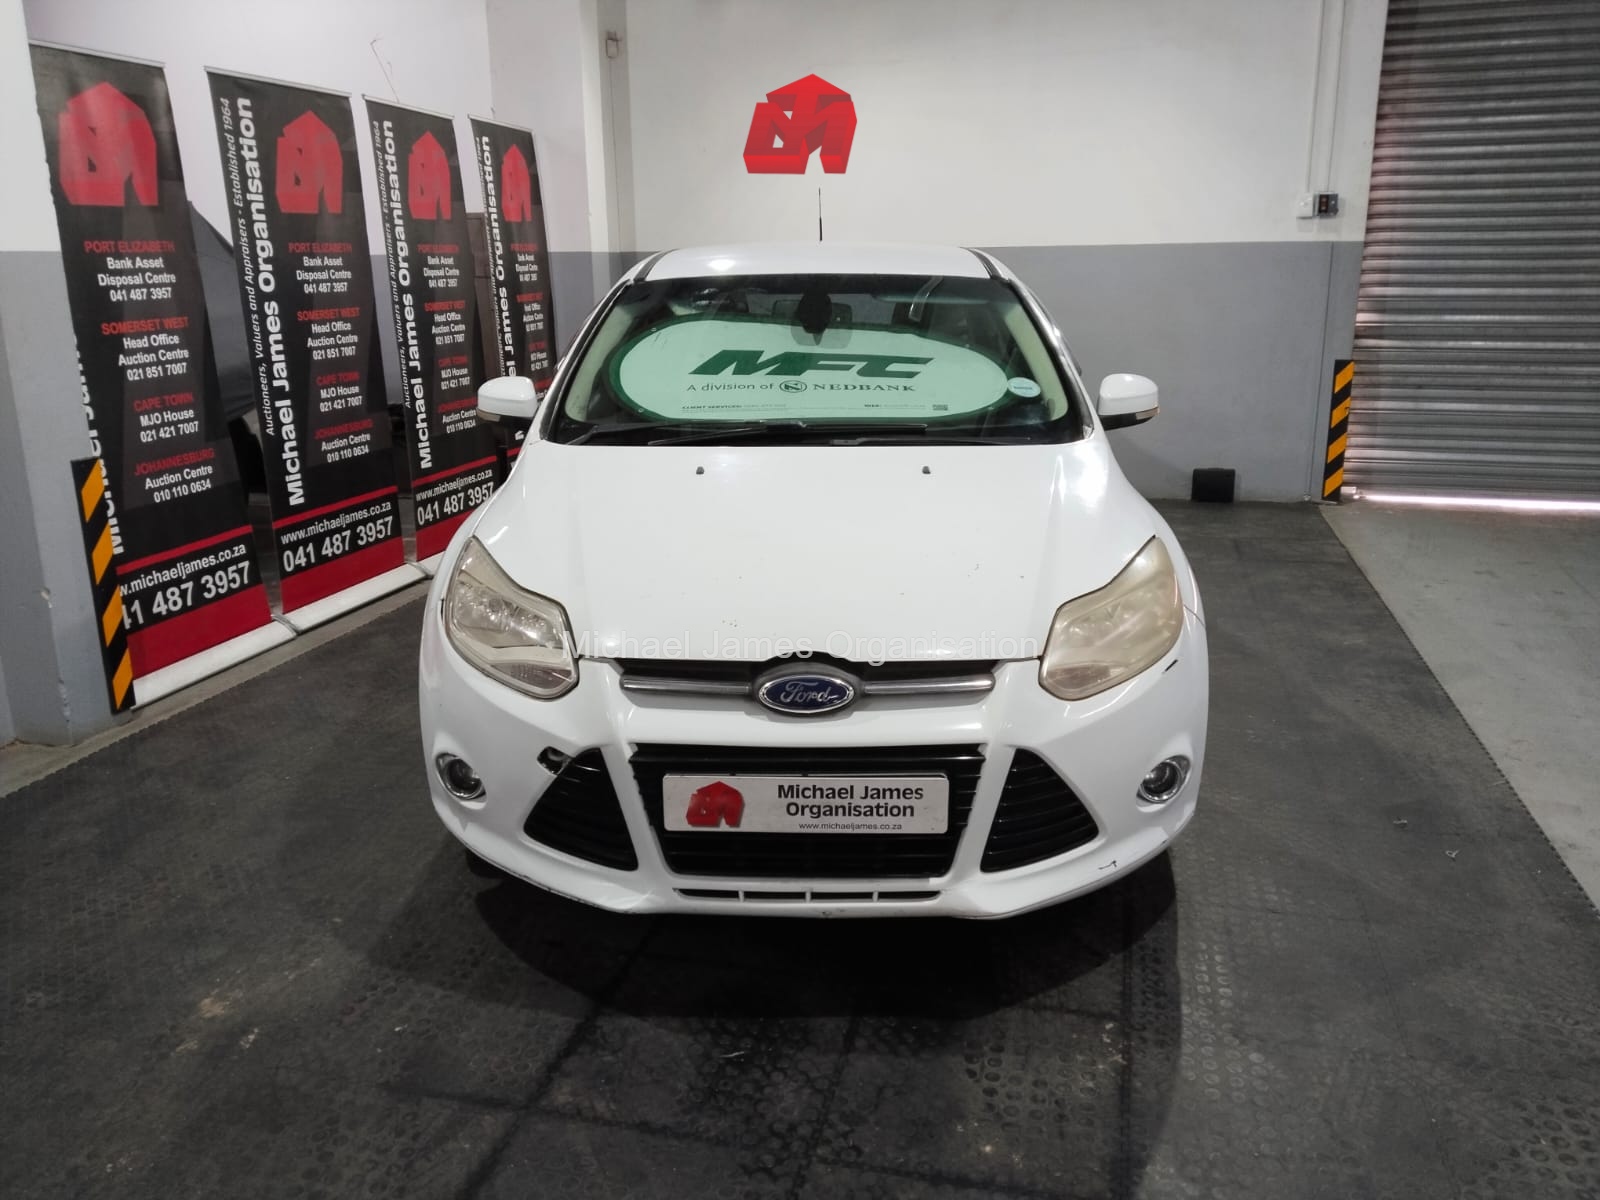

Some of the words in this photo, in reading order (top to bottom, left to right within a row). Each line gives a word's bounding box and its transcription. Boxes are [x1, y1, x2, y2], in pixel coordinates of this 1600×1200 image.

[220, 97, 233, 130] 1964
[226, 134, 244, 207] Established
[237, 97, 276, 293] Organisation
[383, 120, 411, 287] Organisation
[481, 135, 506, 282] Organisation
[84, 241, 114, 253] PORT
[237, 218, 255, 284] Appraisers
[106, 257, 133, 269] Bank
[135, 256, 164, 269] Asset
[303, 256, 322, 266] Bank
[324, 256, 343, 266] Asset
[97, 273, 143, 287] Disposal
[145, 272, 176, 284] Centre
[296, 270, 329, 282] Disposal
[330, 269, 352, 279] Centre
[110, 289, 127, 302] 041
[130, 288, 147, 301] 487
[151, 287, 172, 300] 3957
[246, 286, 258, 310] and
[304, 283, 317, 294] 041
[391, 280, 400, 302] and
[101, 318, 161, 335] SOMERSET
[162, 316, 189, 329] WEST
[312, 323, 330, 334] Head
[331, 321, 351, 331] Office
[403, 293, 421, 371] James
[498, 287, 515, 356] James
[123, 335, 148, 349] Head
[151, 333, 179, 346] Office
[249, 314, 264, 359] Valuers
[263, 300, 290, 393] James
[307, 336, 335, 347] Auction
[336, 334, 358, 344] Centre
[118, 353, 156, 367] Auction
[158, 348, 189, 361] Centre
[313, 350, 325, 360] 021
[688, 349, 936, 379] MFC
[127, 369, 144, 381] 021
[146, 365, 163, 379] 851
[166, 362, 187, 376] 7007
[320, 388, 336, 398] MJO
[337, 386, 359, 396] House
[687, 383, 697, 392] A
[701, 381, 754, 392] division
[761, 381, 775, 392] of
[813, 383, 916, 393] NEDBANK
[257, 362, 275, 436] Auctioneers,
[320, 402, 332, 412] 021
[333, 399, 346, 409] 421
[140, 412, 162, 427] MJO
[163, 408, 194, 423] House
[410, 378, 432, 470] Michael
[140, 428, 158, 443] 021
[159, 425, 176, 439] 421
[177, 421, 199, 436] 7007
[321, 438, 348, 451] Auction
[349, 433, 371, 445] Centre
[275, 399, 305, 506] Michael
[144, 473, 182, 490] Auction
[183, 464, 213, 481] Centre
[415, 468, 493, 501] www.michaeljames.co.za
[153, 489, 169, 503] 010
[171, 484, 188, 499] 110
[189, 479, 212, 495] 0634
[417, 501, 440, 526] 041
[443, 491, 464, 516] 487
[468, 481, 494, 507] 3957
[280, 501, 392, 546] www.michaeljames.co.za
[283, 542, 315, 573] 041
[321, 530, 352, 558] 487
[356, 515, 394, 546] 3957
[152, 581, 194, 617] 487
[200, 560, 250, 600] 3957
[779, 680, 841, 704] Ford
[777, 783, 855, 800] Michael
[860, 784, 924, 800] James
[786, 802, 914, 819] Organisation
[799, 822, 903, 832] www.michaeljames.co.za
